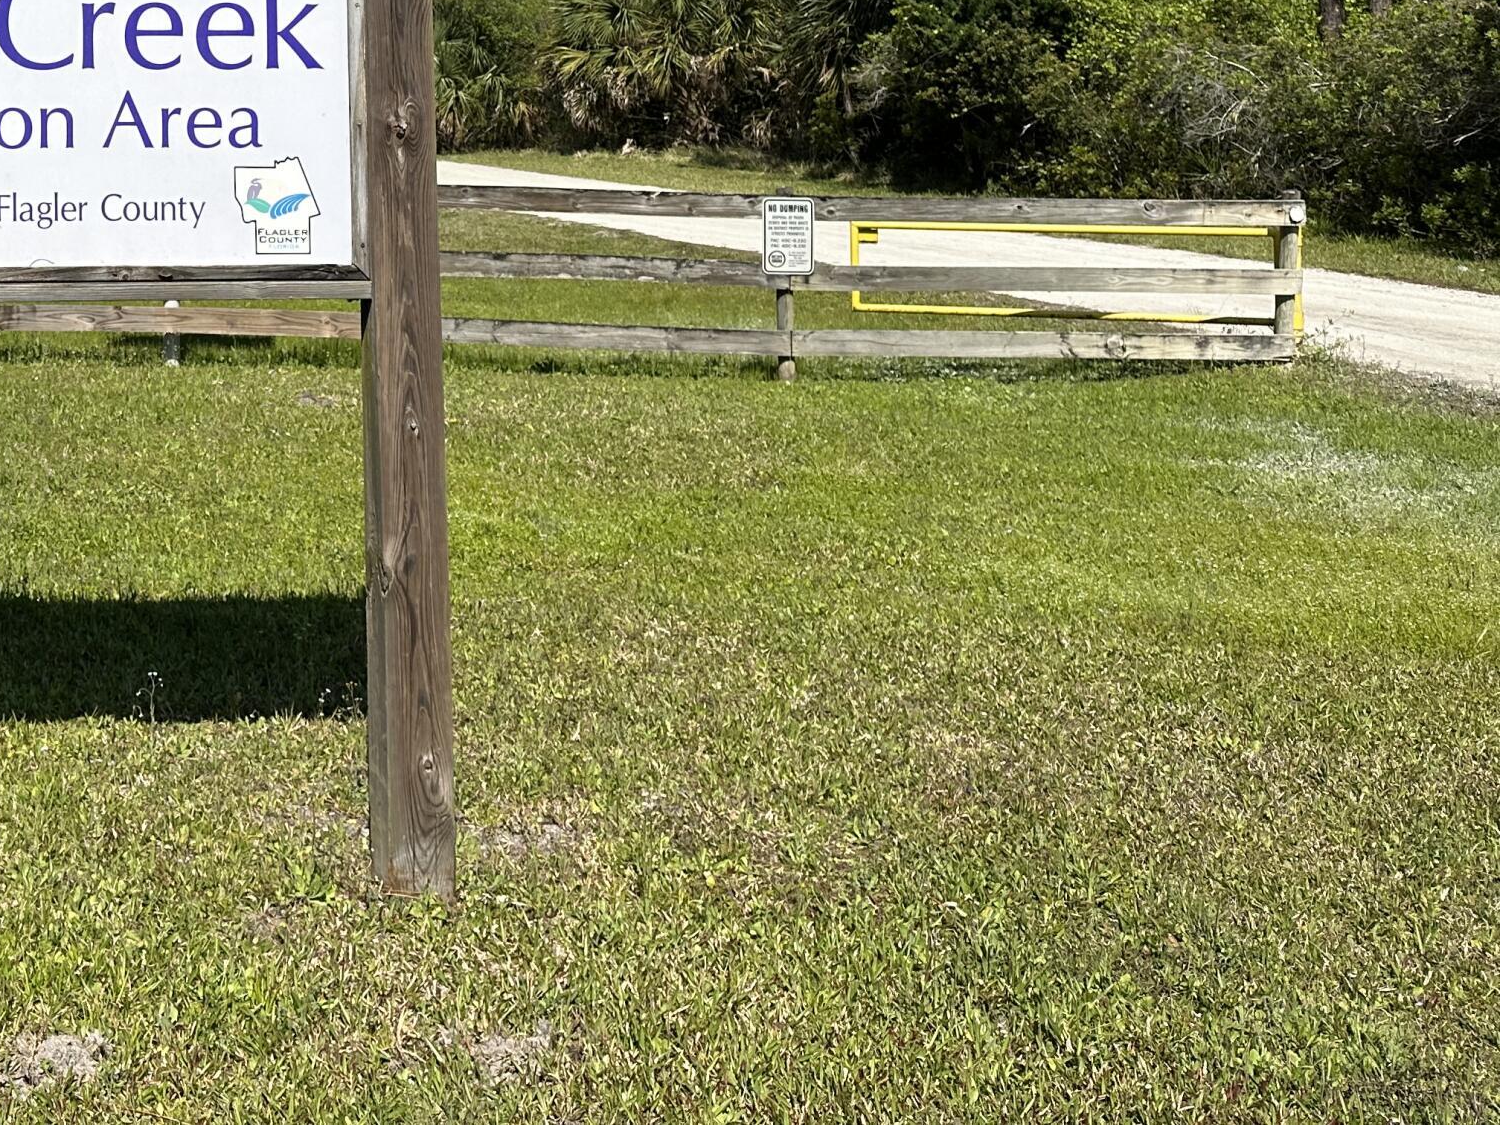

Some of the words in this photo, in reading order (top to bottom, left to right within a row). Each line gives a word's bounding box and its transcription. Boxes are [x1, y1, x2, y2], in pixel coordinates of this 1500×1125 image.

[102, 89, 264, 149] Area
[100, 193, 206, 229] County
[768, 204, 777, 213] NO
[780, 204, 808, 213] DUMPING
[257, 227, 308, 236] FLAGLER
[259, 235, 307, 244] COUNTY
